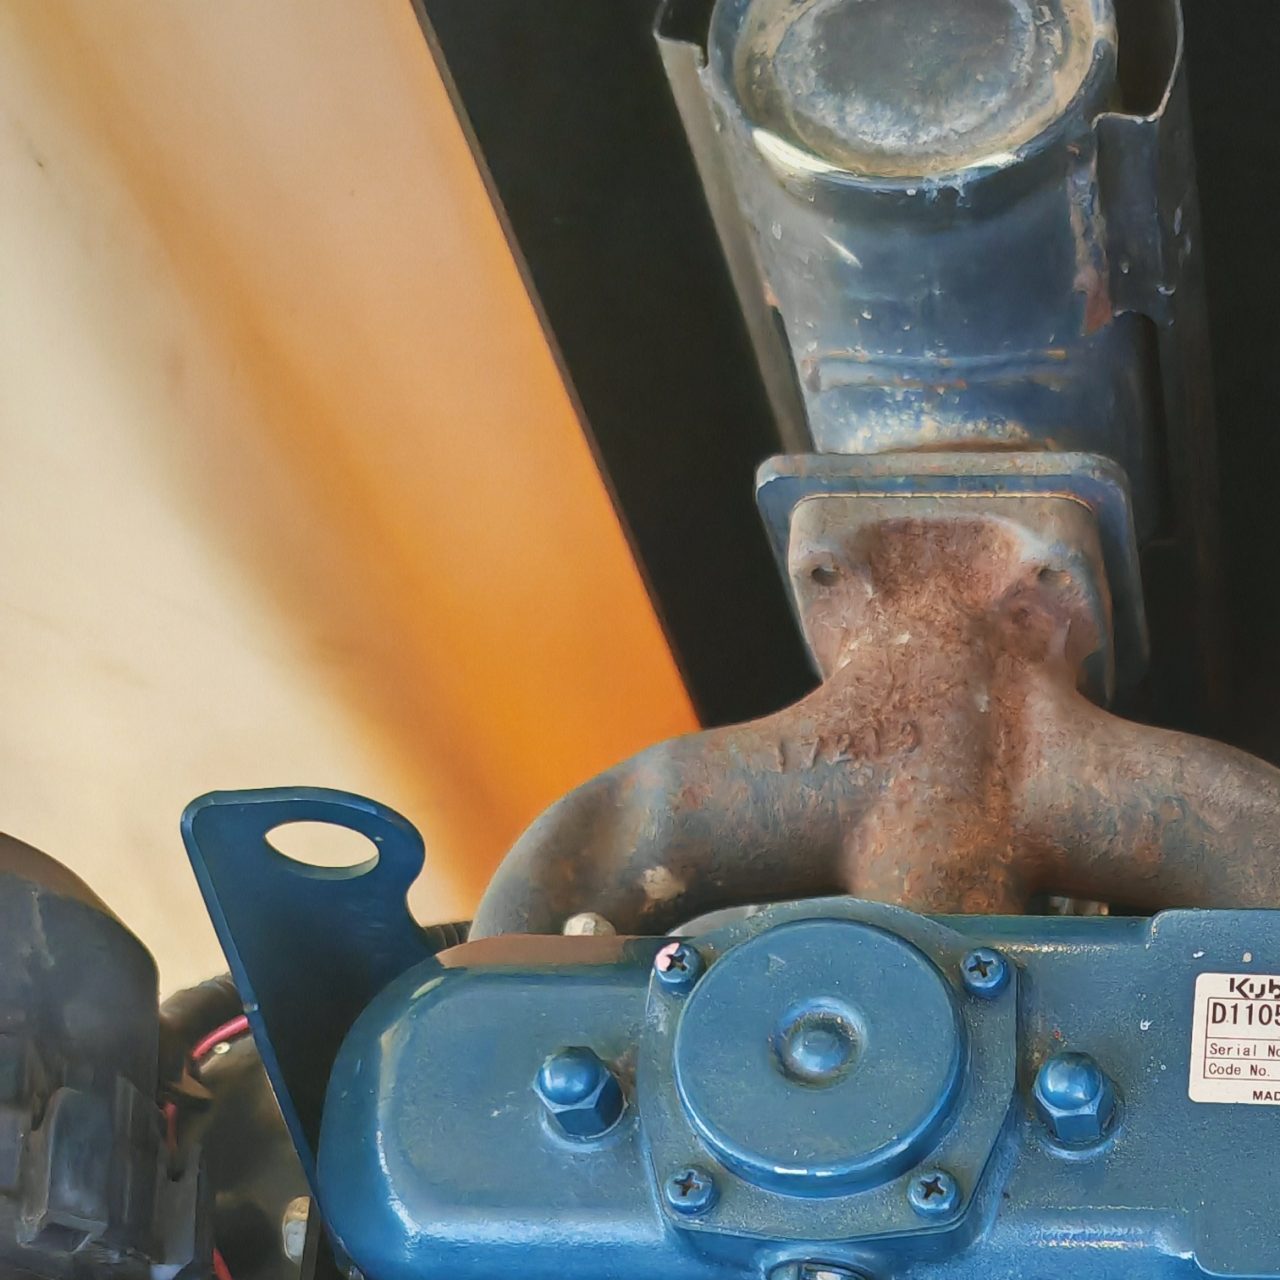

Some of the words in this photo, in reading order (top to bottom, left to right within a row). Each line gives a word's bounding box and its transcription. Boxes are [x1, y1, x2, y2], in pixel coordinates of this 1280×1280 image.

[1210, 1043, 1257, 1057] Serial
[1208, 1063, 1241, 1076] Code
[1250, 1065, 1270, 1077] No.
